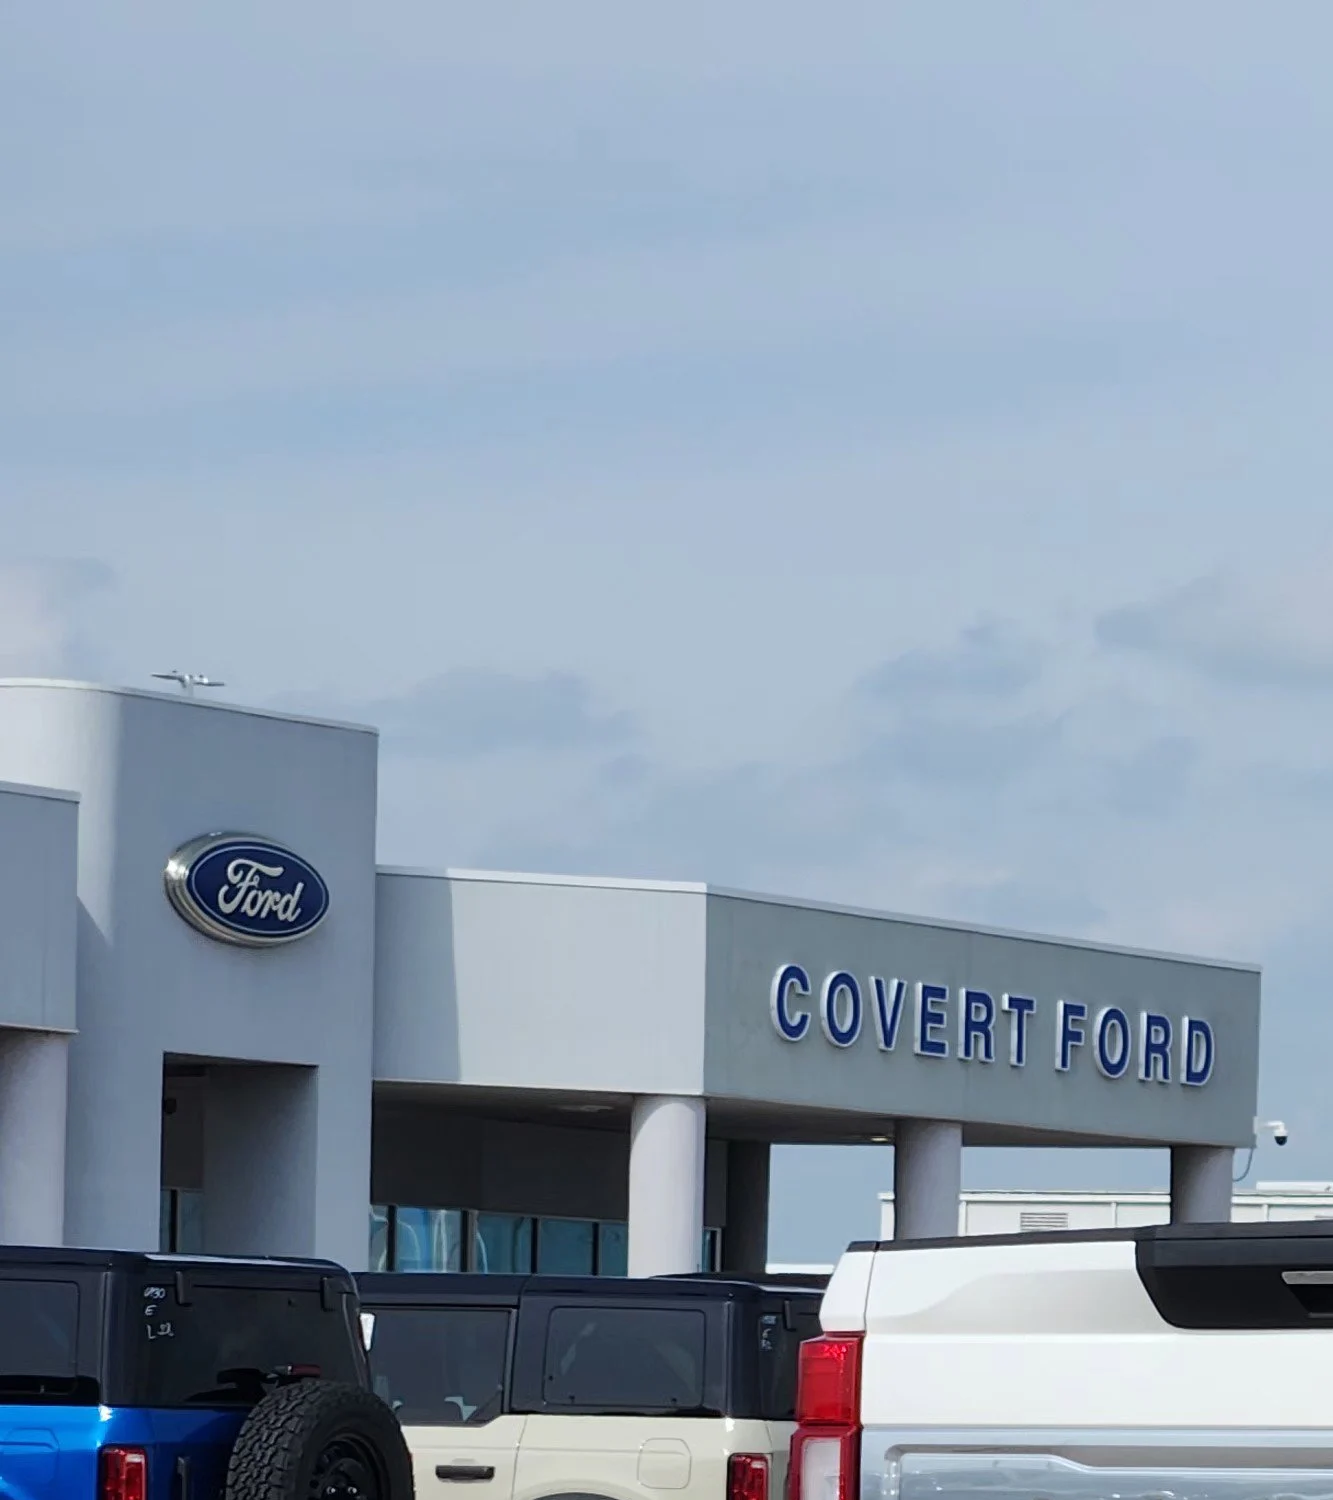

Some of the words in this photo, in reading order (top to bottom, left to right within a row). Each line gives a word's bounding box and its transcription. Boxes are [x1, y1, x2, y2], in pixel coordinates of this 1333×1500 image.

[218, 858, 304, 923] Ford
[770, 963, 1036, 1068] COVERT
[1055, 999, 1216, 1087] FORD
